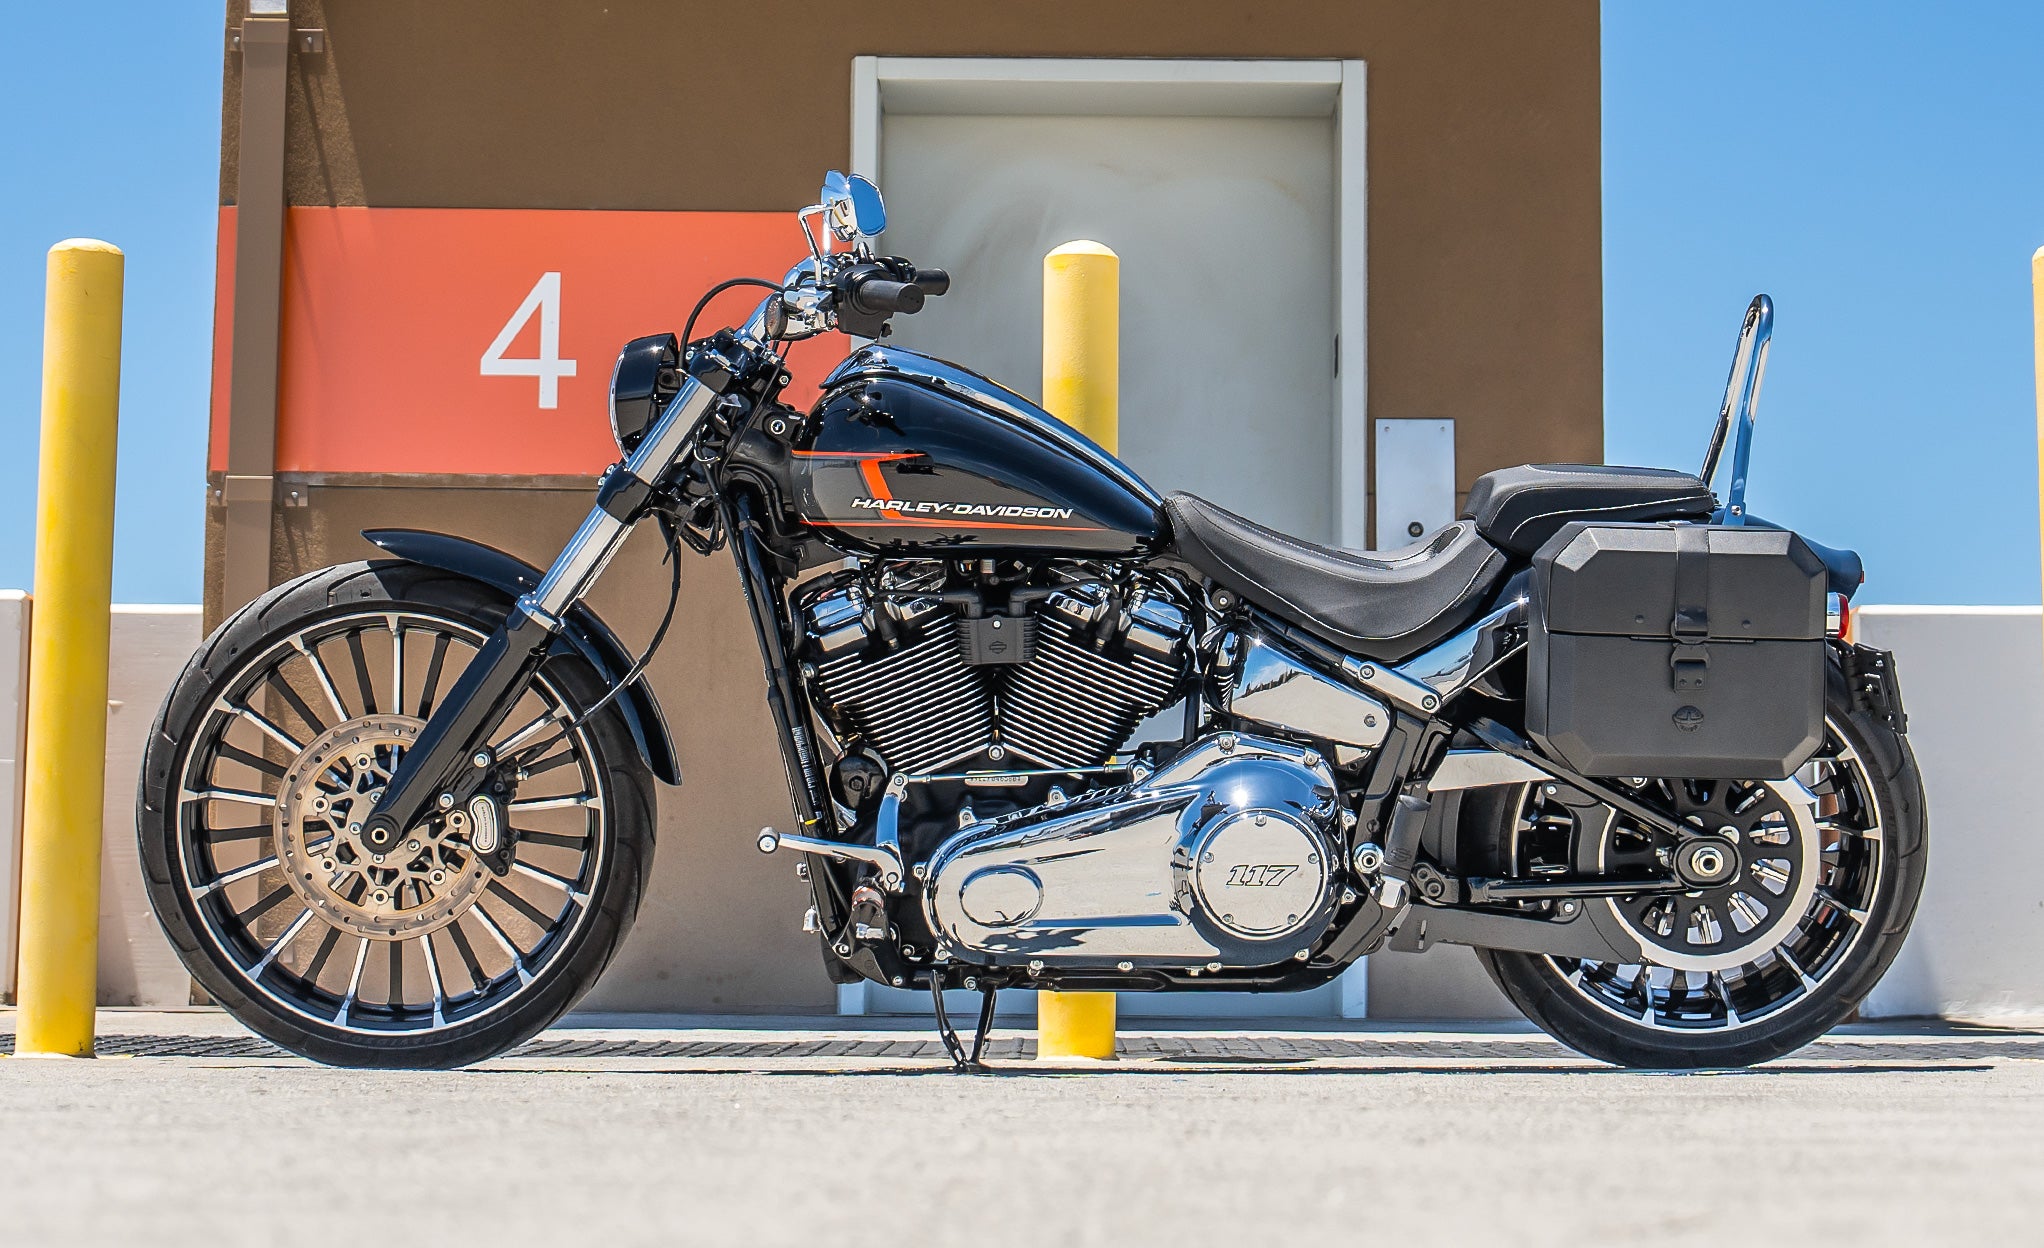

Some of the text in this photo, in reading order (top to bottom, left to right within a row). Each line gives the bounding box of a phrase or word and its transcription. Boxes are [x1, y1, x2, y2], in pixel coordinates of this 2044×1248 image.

[480, 271, 577, 409] 4
[851, 498, 1073, 518] HARLEY-DAVIDSON
[1226, 865, 1299, 886] 117
